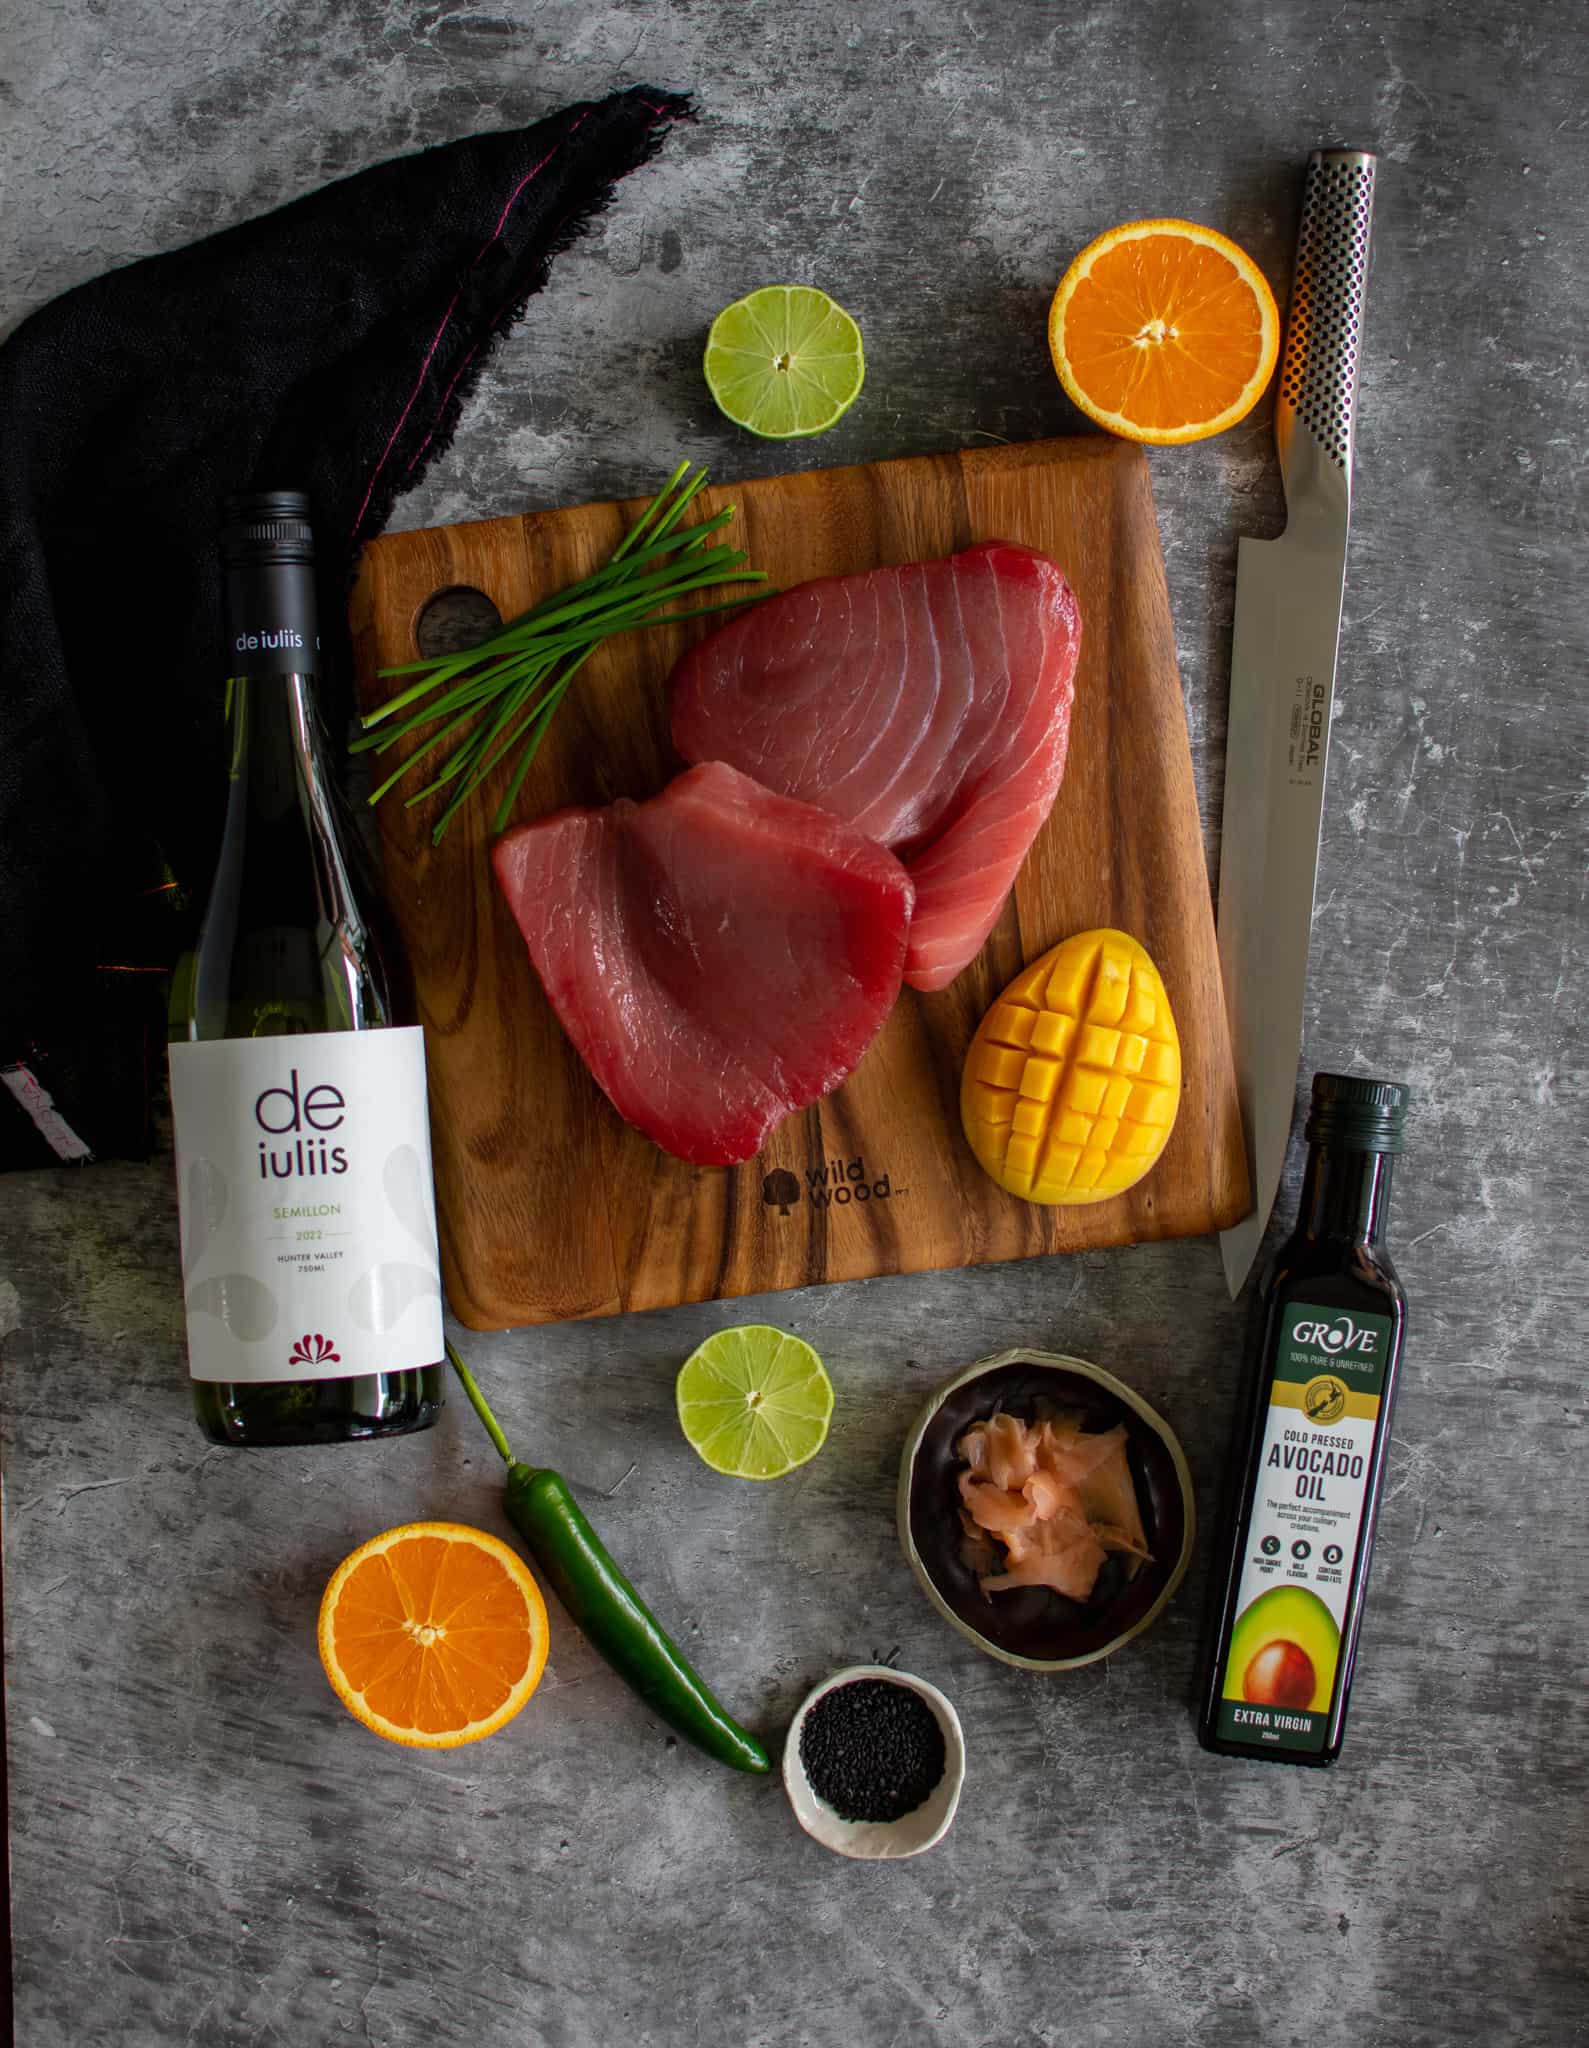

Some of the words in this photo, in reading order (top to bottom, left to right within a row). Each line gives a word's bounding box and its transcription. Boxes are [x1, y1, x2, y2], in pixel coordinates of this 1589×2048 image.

[236, 632, 259, 651] de
[261, 629, 304, 649] iuliis
[1307, 684, 1325, 766] GLOBAL
[256, 1069, 345, 1134] de
[258, 1138, 348, 1179] iuliis
[805, 1157, 865, 1187] wild
[808, 1174, 891, 1208] wood
[273, 1204, 341, 1219] SEMILLON
[296, 1230, 323, 1241] 2022
[277, 1253, 311, 1263] HUNTER
[314, 1251, 344, 1261] VALLEY
[1293, 1317, 1378, 1353] GROVE
[1311, 1355, 1328, 1367] PURE
[1284, 1430, 1308, 1444] COLD
[1311, 1434, 1353, 1450] PRESSED
[1267, 1444, 1363, 1479] AVOCADO
[1295, 1474, 1326, 1501] OIL
[1267, 1499, 1277, 1508] The
[1278, 1503, 1301, 1512] perfect
[1297, 1515, 1312, 1523] your
[1233, 1709, 1270, 1726] EXTRA
[1274, 1715, 1312, 1732] VIRGIN
